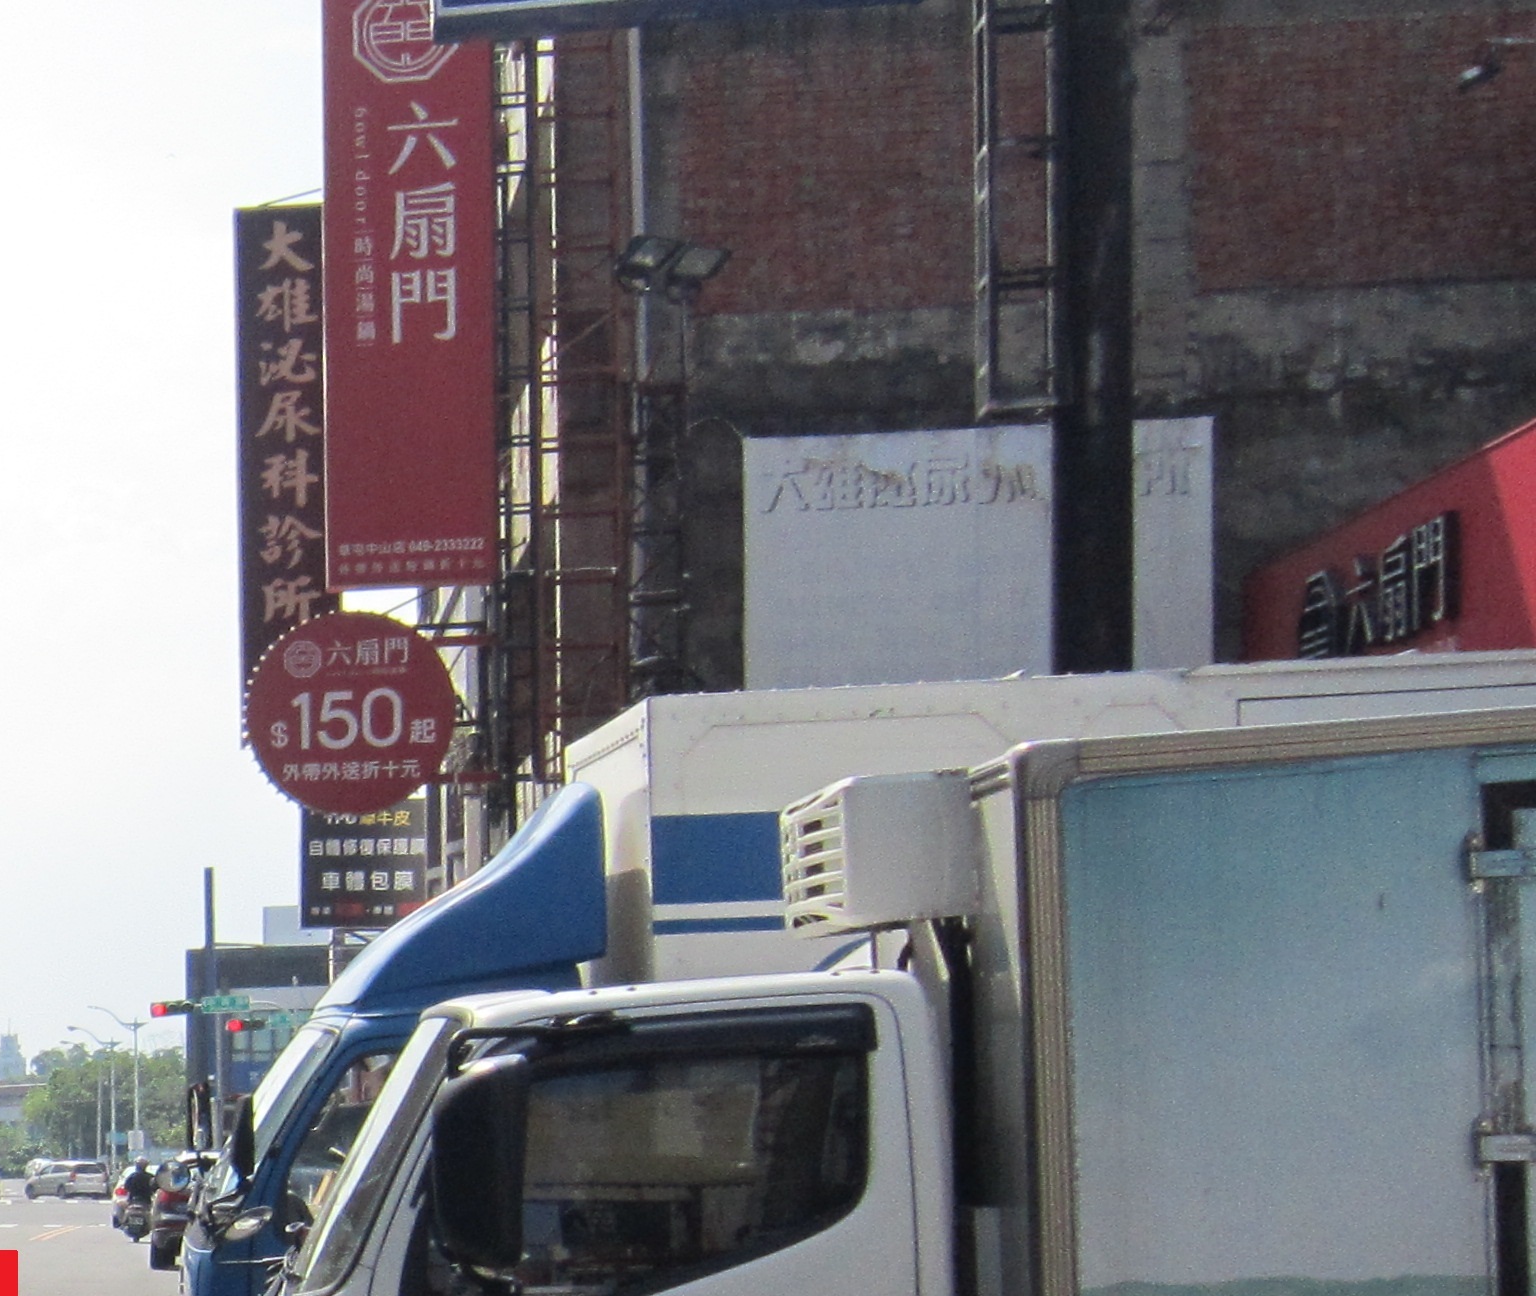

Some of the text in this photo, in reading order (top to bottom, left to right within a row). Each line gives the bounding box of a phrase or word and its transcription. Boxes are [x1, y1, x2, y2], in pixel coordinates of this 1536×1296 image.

[386, 101, 459, 345] 六扇門
[255, 221, 323, 622] 大雄泌尿科診所
[326, 636, 410, 668] 六扇門
[1344, 515, 1446, 655] 六扇門
[282, 758, 422, 782] 外帶外送折十元
